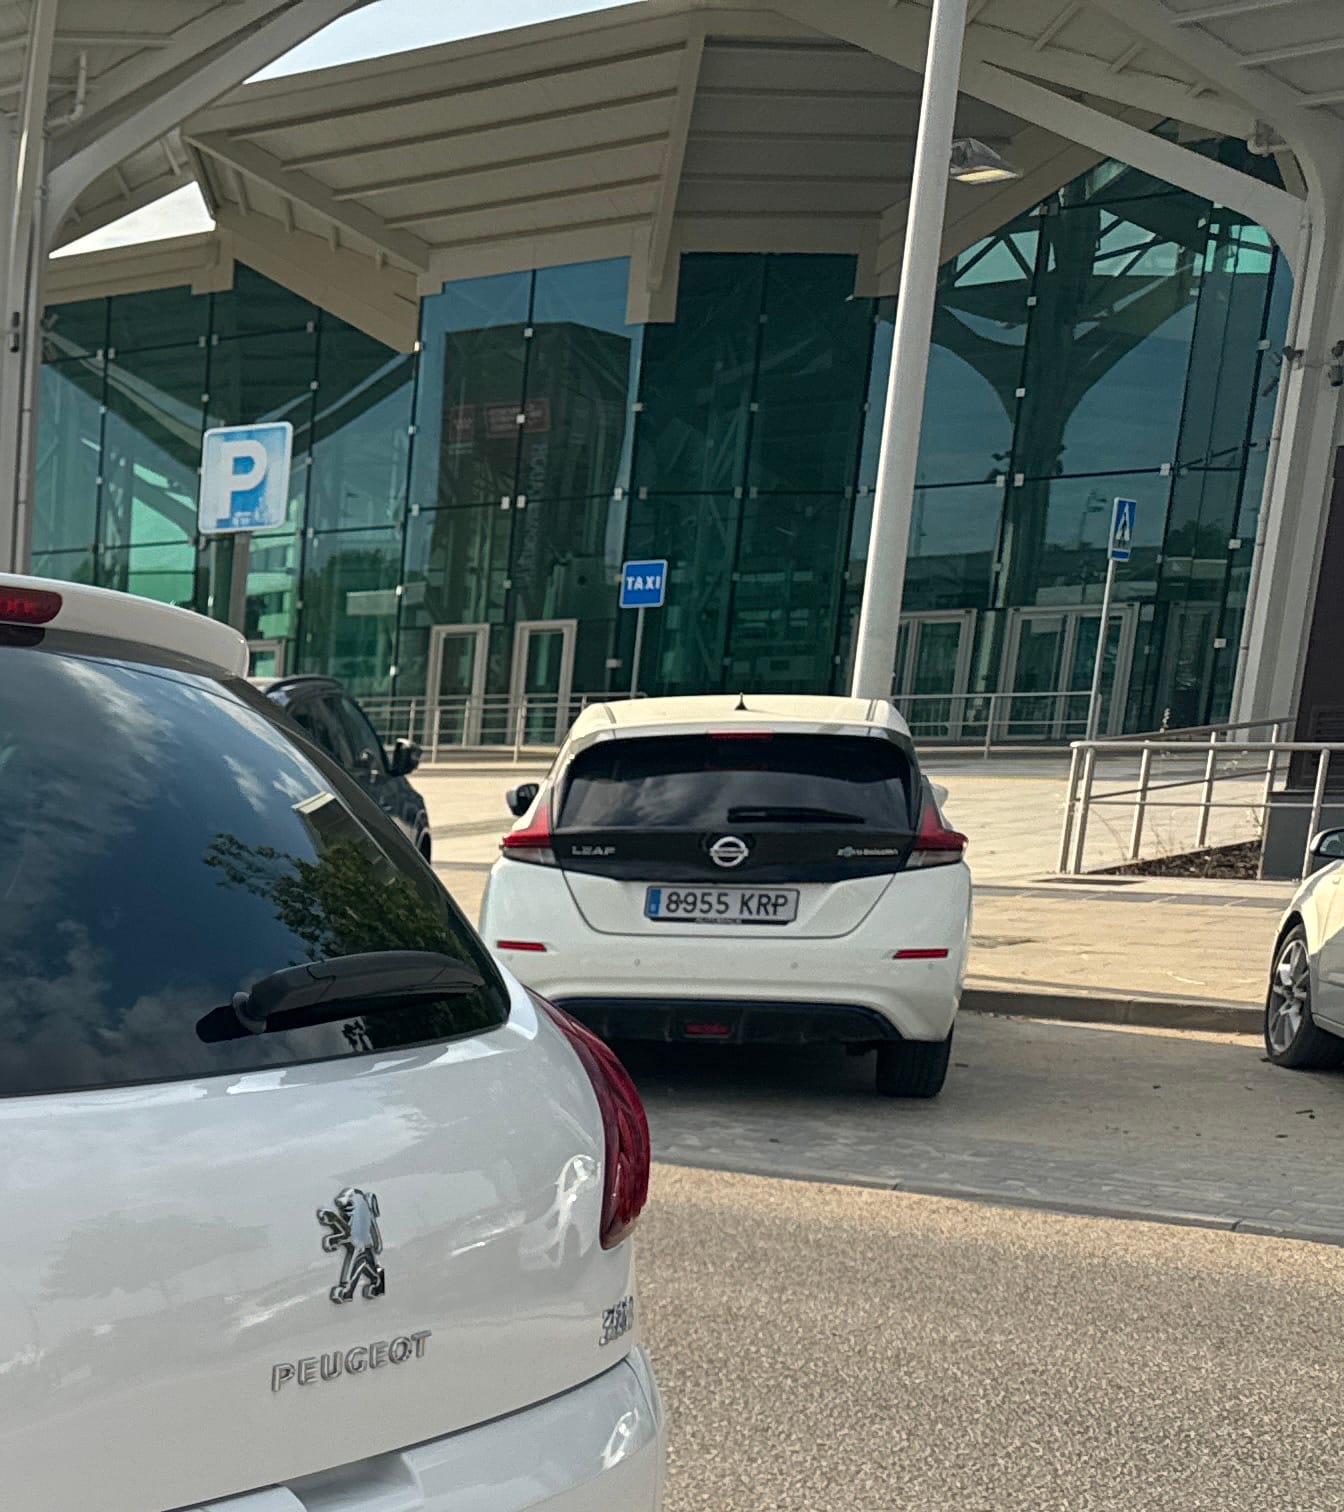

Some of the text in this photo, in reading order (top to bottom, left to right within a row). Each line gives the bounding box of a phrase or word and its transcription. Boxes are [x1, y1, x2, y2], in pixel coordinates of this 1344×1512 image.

[216, 440, 268, 520] P
[626, 575, 662, 591] TAXI
[665, 891, 789, 916] 8955 KRP
[271, 1330, 433, 1393] PEUGEOT
